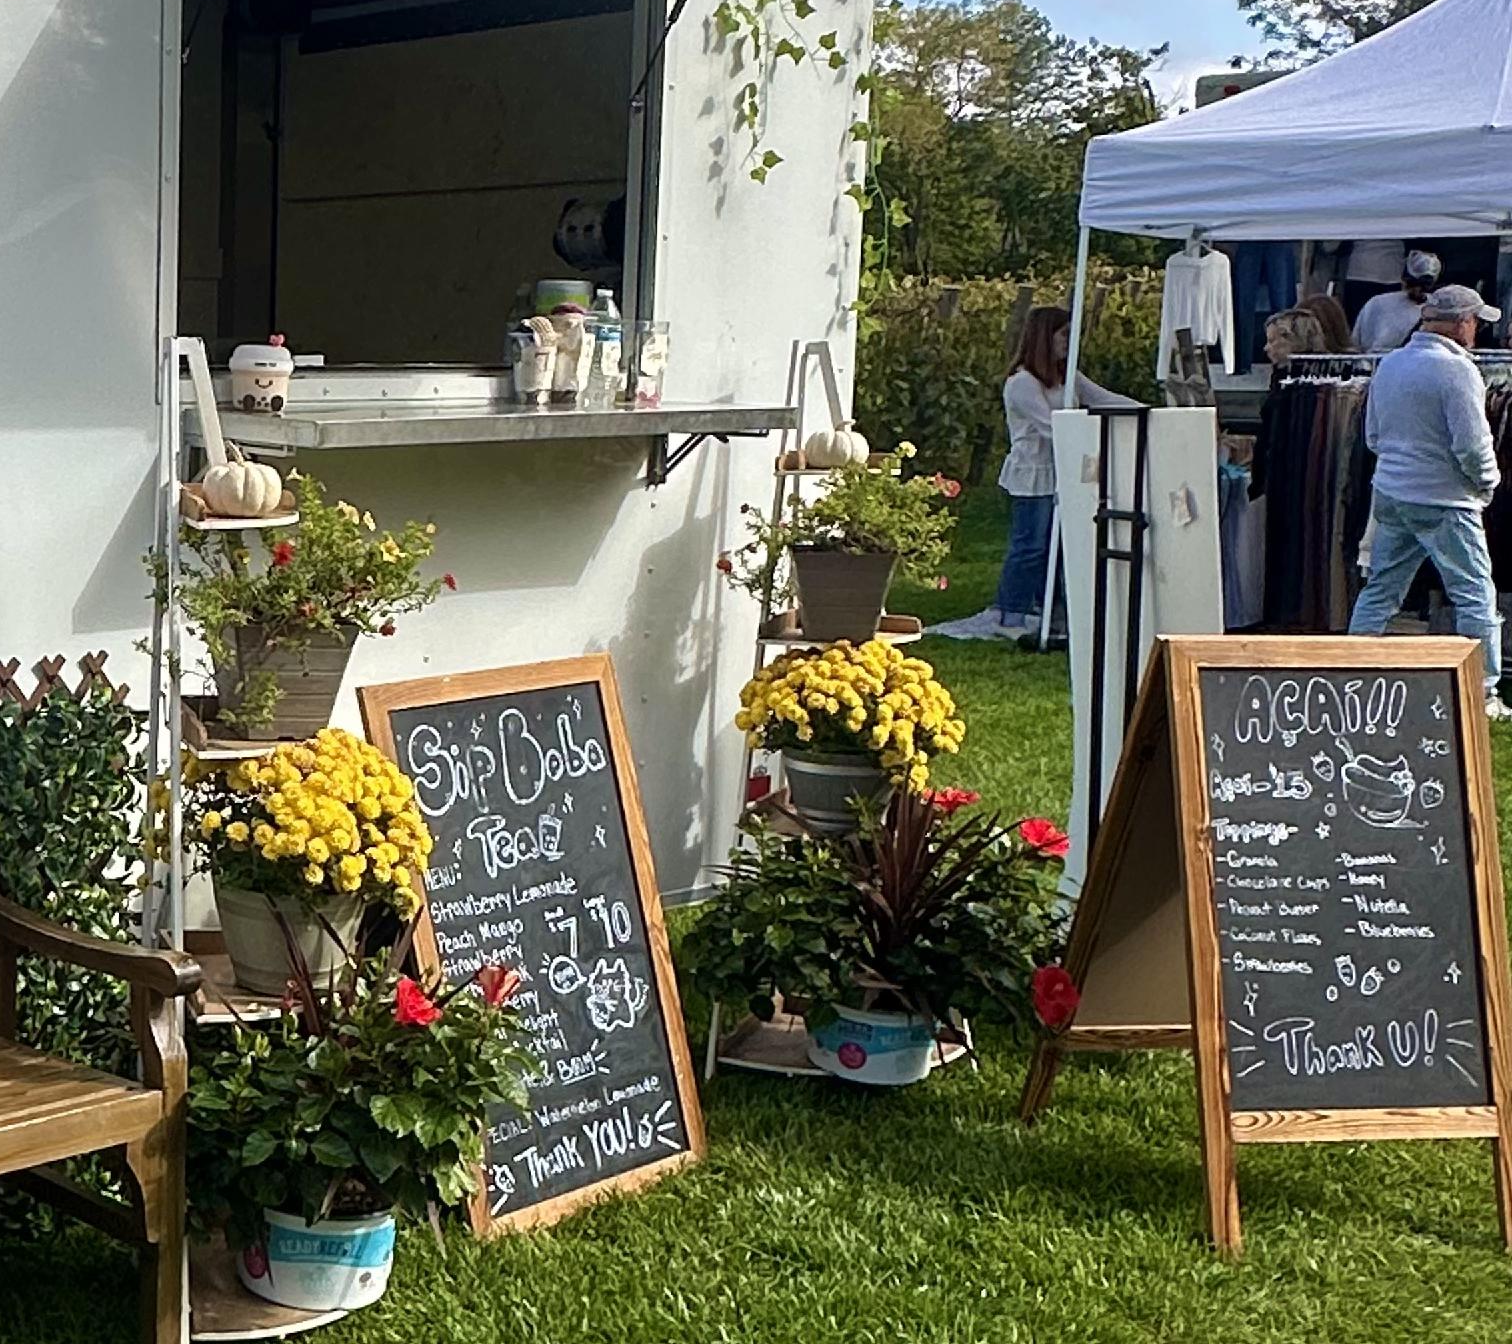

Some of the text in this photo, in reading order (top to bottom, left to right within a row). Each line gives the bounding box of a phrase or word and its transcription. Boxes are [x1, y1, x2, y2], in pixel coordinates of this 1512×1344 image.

[498, 707, 607, 806] Boba
[466, 814, 540, 879] Tea
[430, 892, 513, 924] Strawberry
[512, 871, 579, 906] Lemonade
[436, 918, 525, 955] Peach Mango
